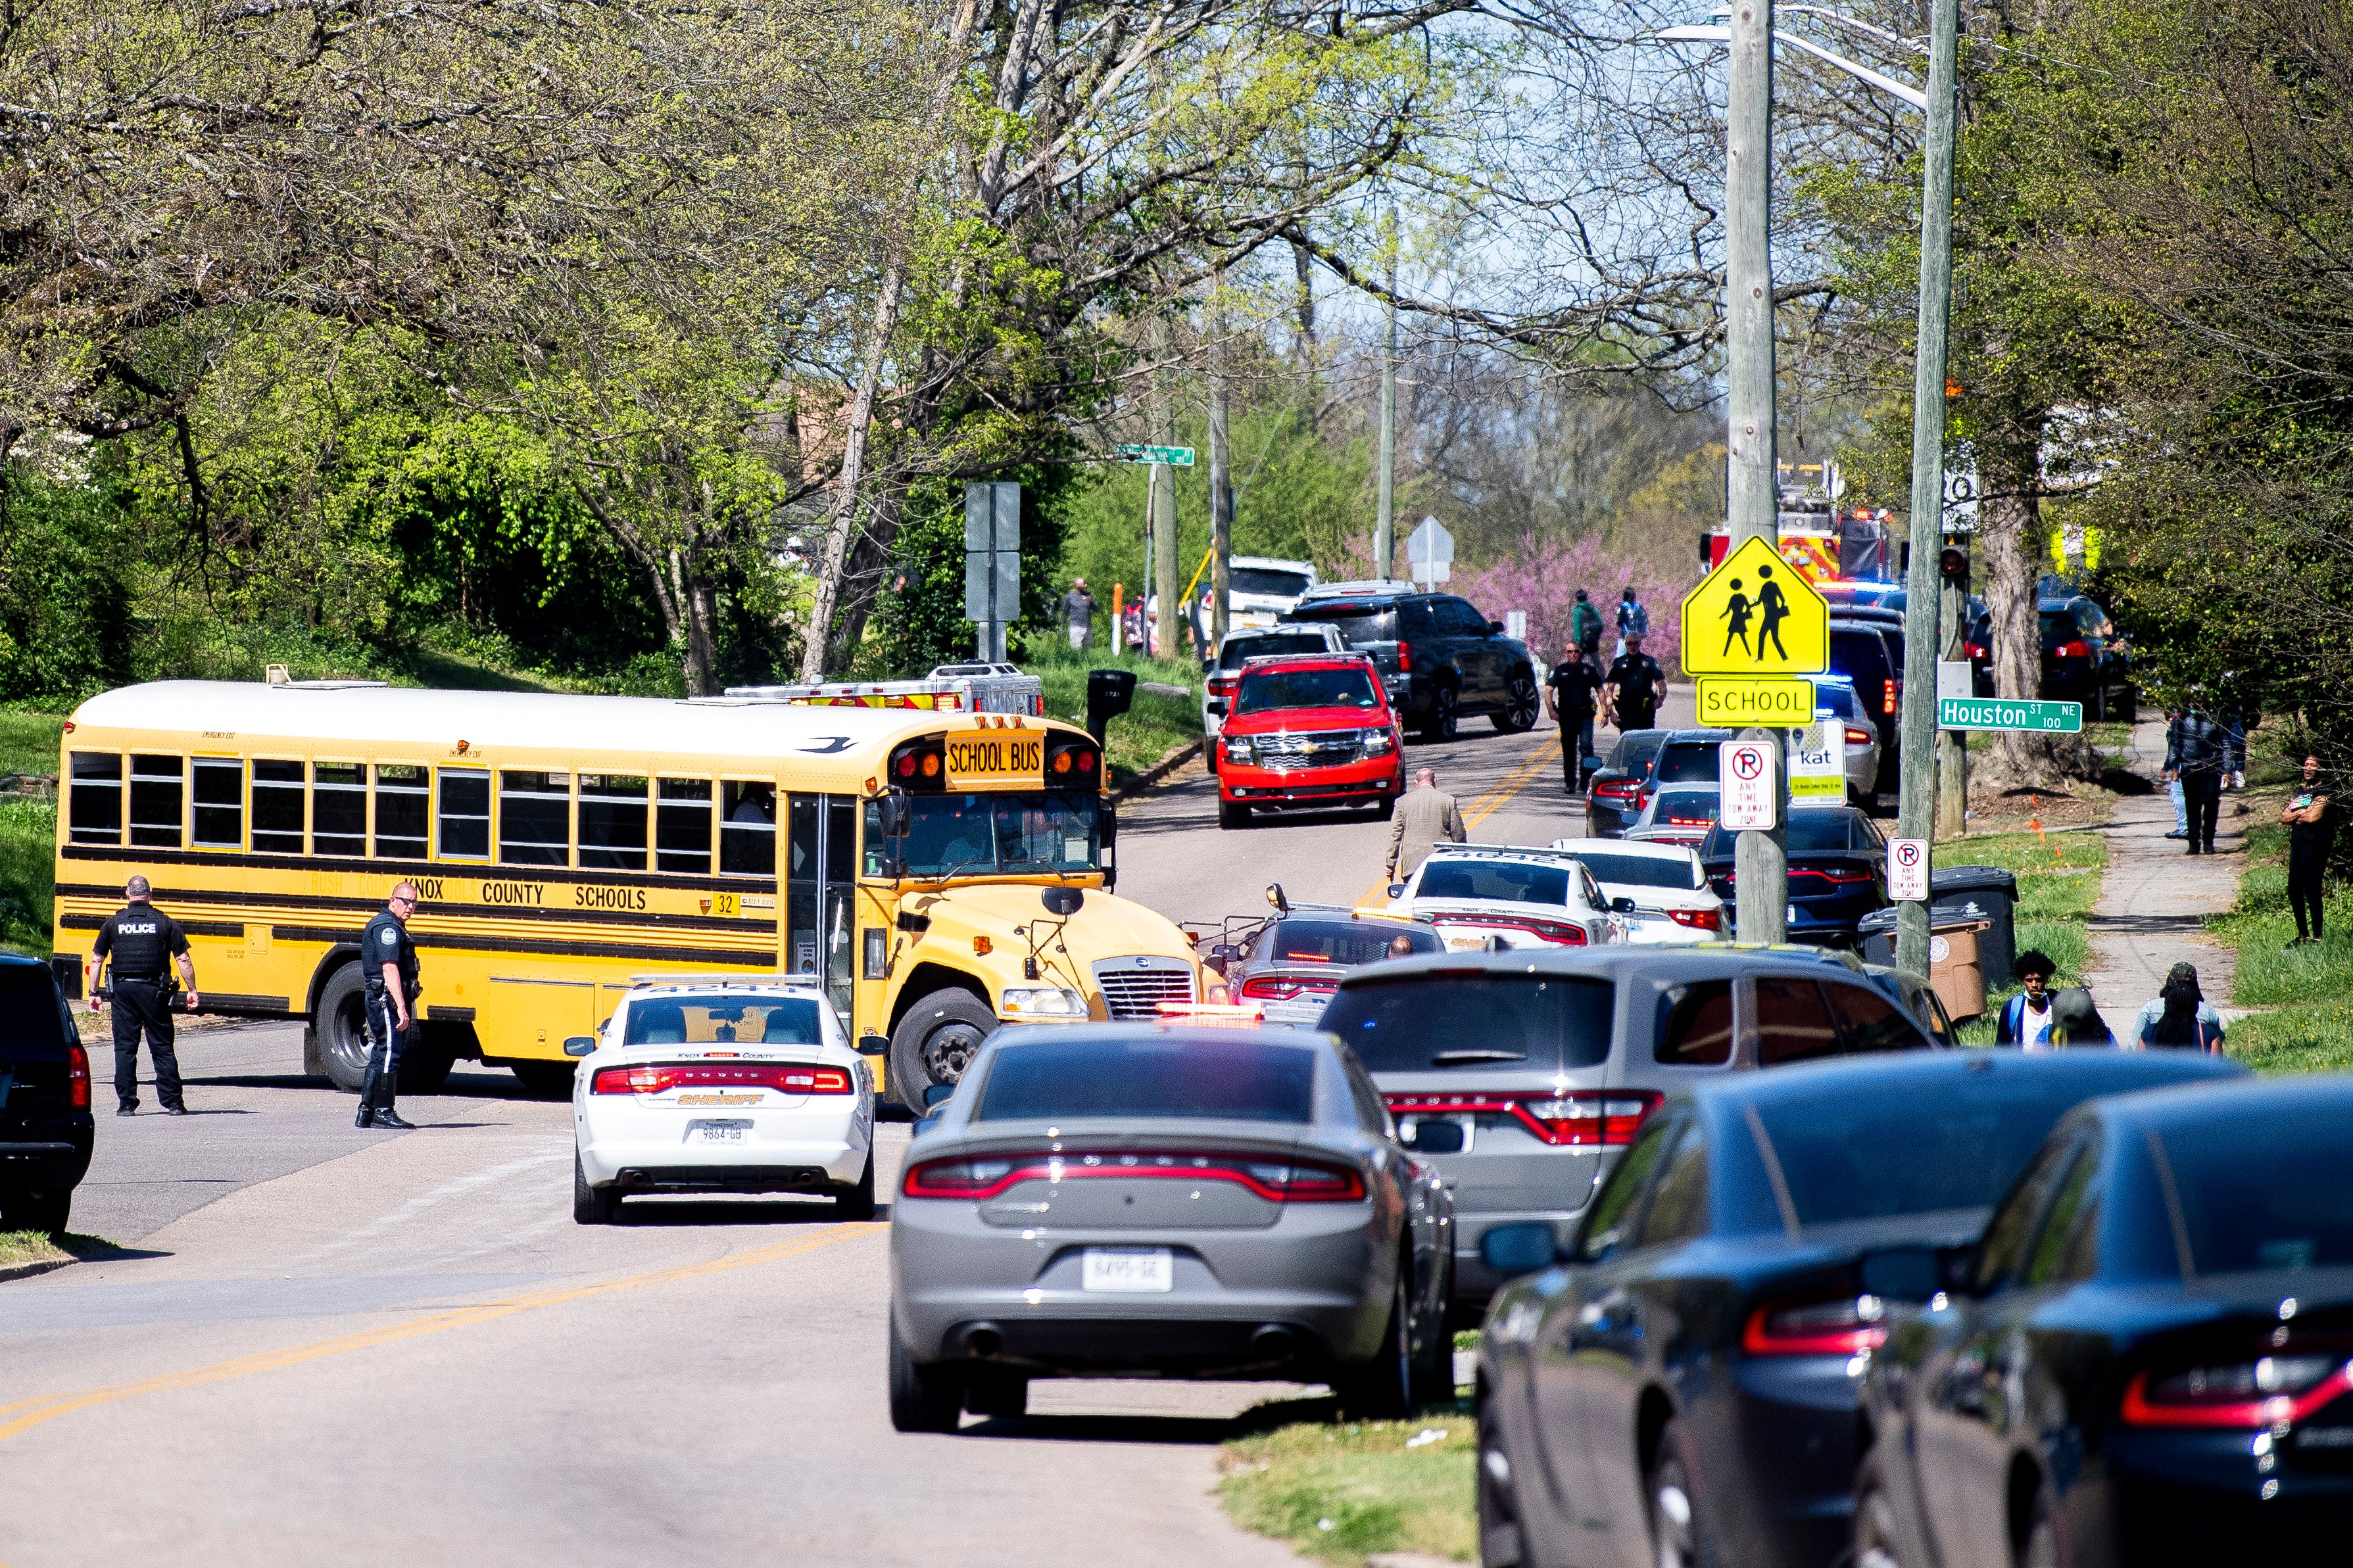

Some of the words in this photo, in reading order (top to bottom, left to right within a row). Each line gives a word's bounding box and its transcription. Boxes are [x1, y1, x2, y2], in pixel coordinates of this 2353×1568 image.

[1708, 692, 1806, 710] SCHOOL
[1944, 701, 2026, 726] Houston
[2029, 703, 2043, 715] ST
[2062, 705, 2075, 717] NE
[2043, 717, 2061, 728] 100
[949, 742, 1007, 772] SCHOOL
[1011, 742, 1040, 771] BUS
[1801, 749, 1831, 764] kat
[1739, 782, 1757, 791] ANY
[1739, 793, 1757, 801] TIME
[1728, 804, 1742, 813] TOW
[1747, 804, 1768, 813] AWAY
[1739, 815, 1757, 824] ZONE
[404, 878, 444, 899] KNOX
[482, 882, 544, 904] COUNTY
[575, 886, 646, 910] SCHOOLS
[719, 895, 733, 914] 32
[118, 923, 157, 934] POLICE
[677, 1094, 765, 1105] SHERIFF
[702, 1128, 742, 1139] 9864-GB
